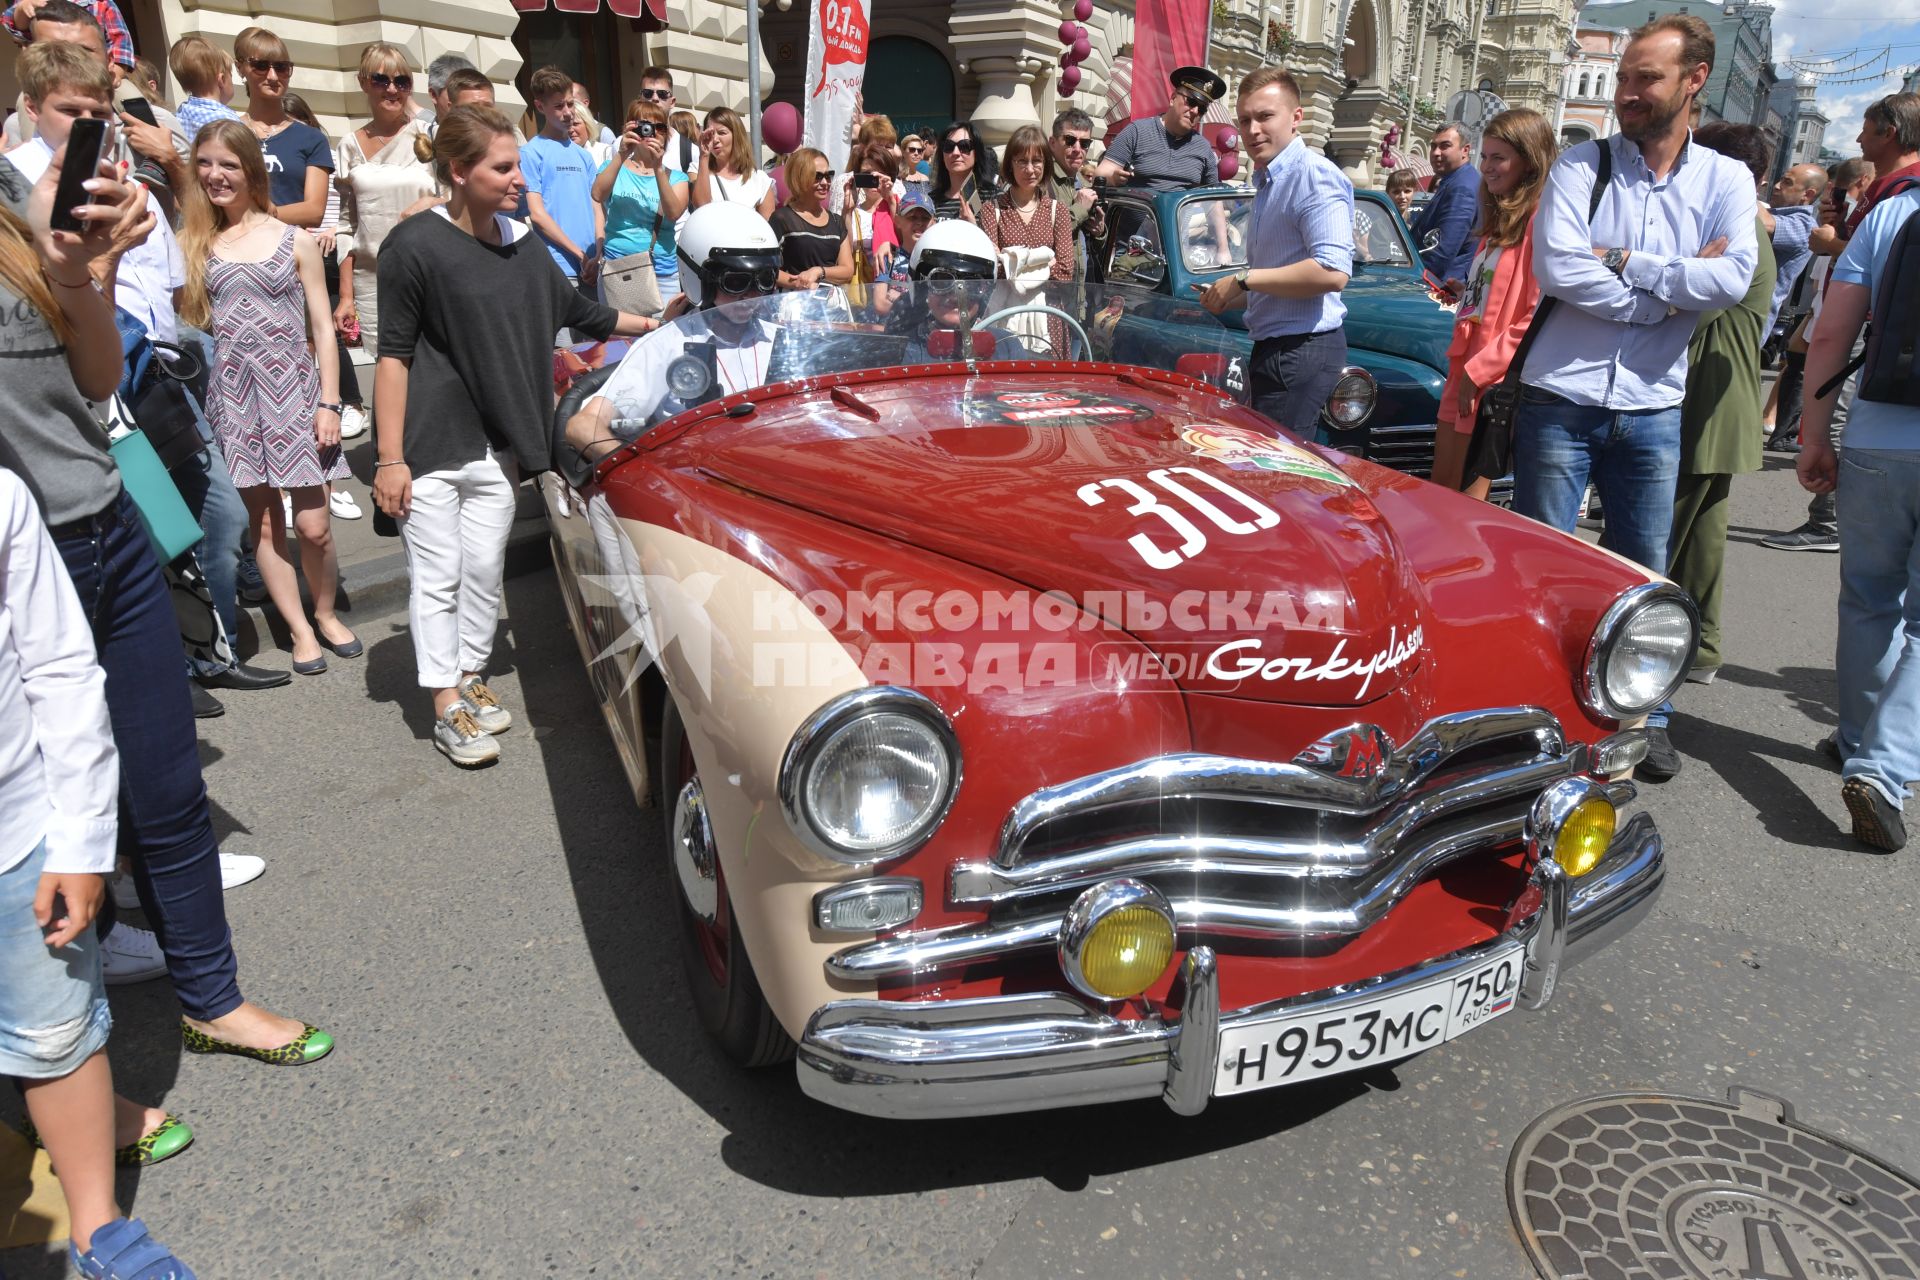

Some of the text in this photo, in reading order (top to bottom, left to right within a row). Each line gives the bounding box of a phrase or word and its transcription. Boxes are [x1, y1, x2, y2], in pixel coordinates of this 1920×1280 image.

[1226, 378, 1243, 391] ГАЗ
[1003, 395, 1075, 405] MOTUL
[1015, 406, 1127, 421] MOTUL
[1077, 467, 1280, 569] 30
[1235, 961, 1512, 1086] Н953МС 750
[1462, 1004, 1491, 1026] RUS
